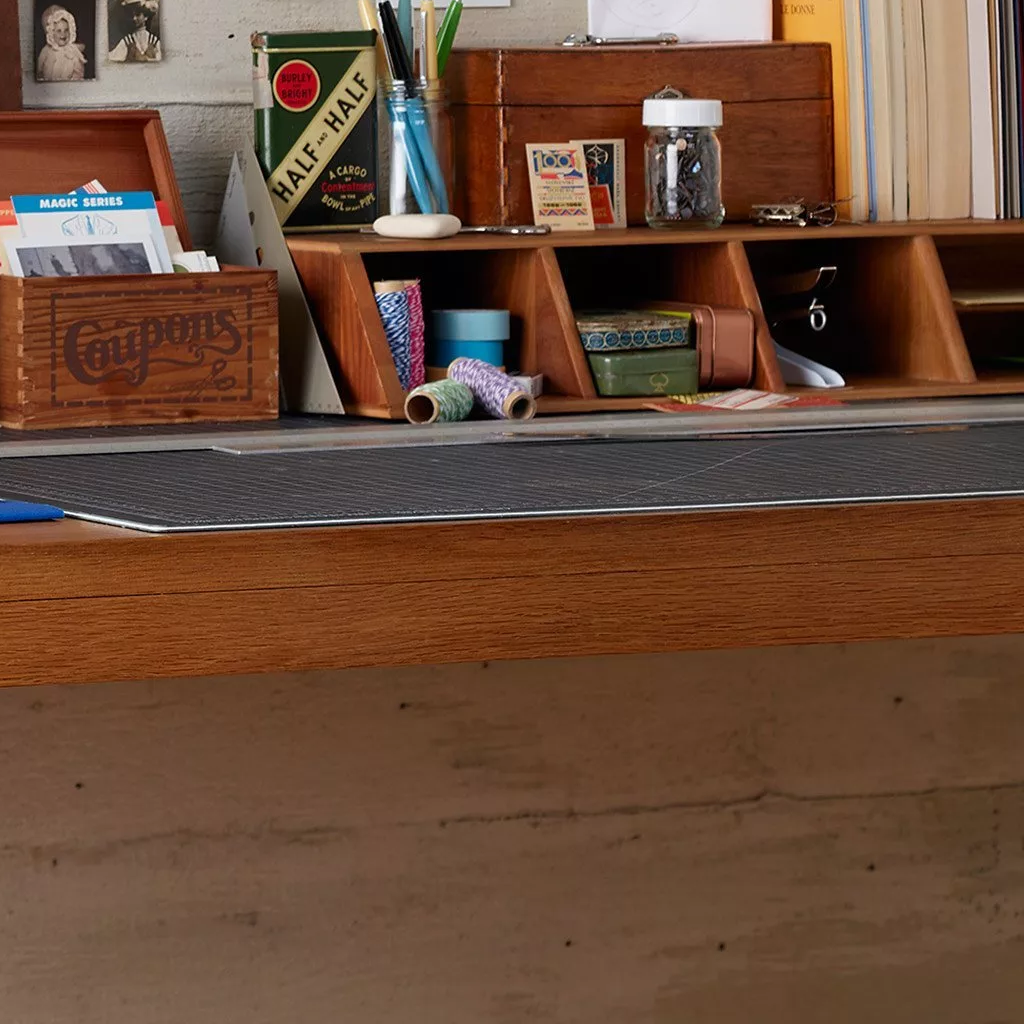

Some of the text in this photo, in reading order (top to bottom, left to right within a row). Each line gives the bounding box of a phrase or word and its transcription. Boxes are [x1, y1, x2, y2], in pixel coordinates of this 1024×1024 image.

[282, 73, 311, 83] BURLEY
[282, 88, 312, 98] BRIGHT
[271, 143, 319, 204] HALF
[317, 132, 329, 146] AND
[324, 72, 369, 133] HALF
[329, 165, 367, 180] A CARGO
[40, 196, 123, 208] MAGIC SERIES
[321, 194, 344, 211] BOWL
[360, 192, 376, 208] PIPE
[63, 308, 242, 387] Coupons
